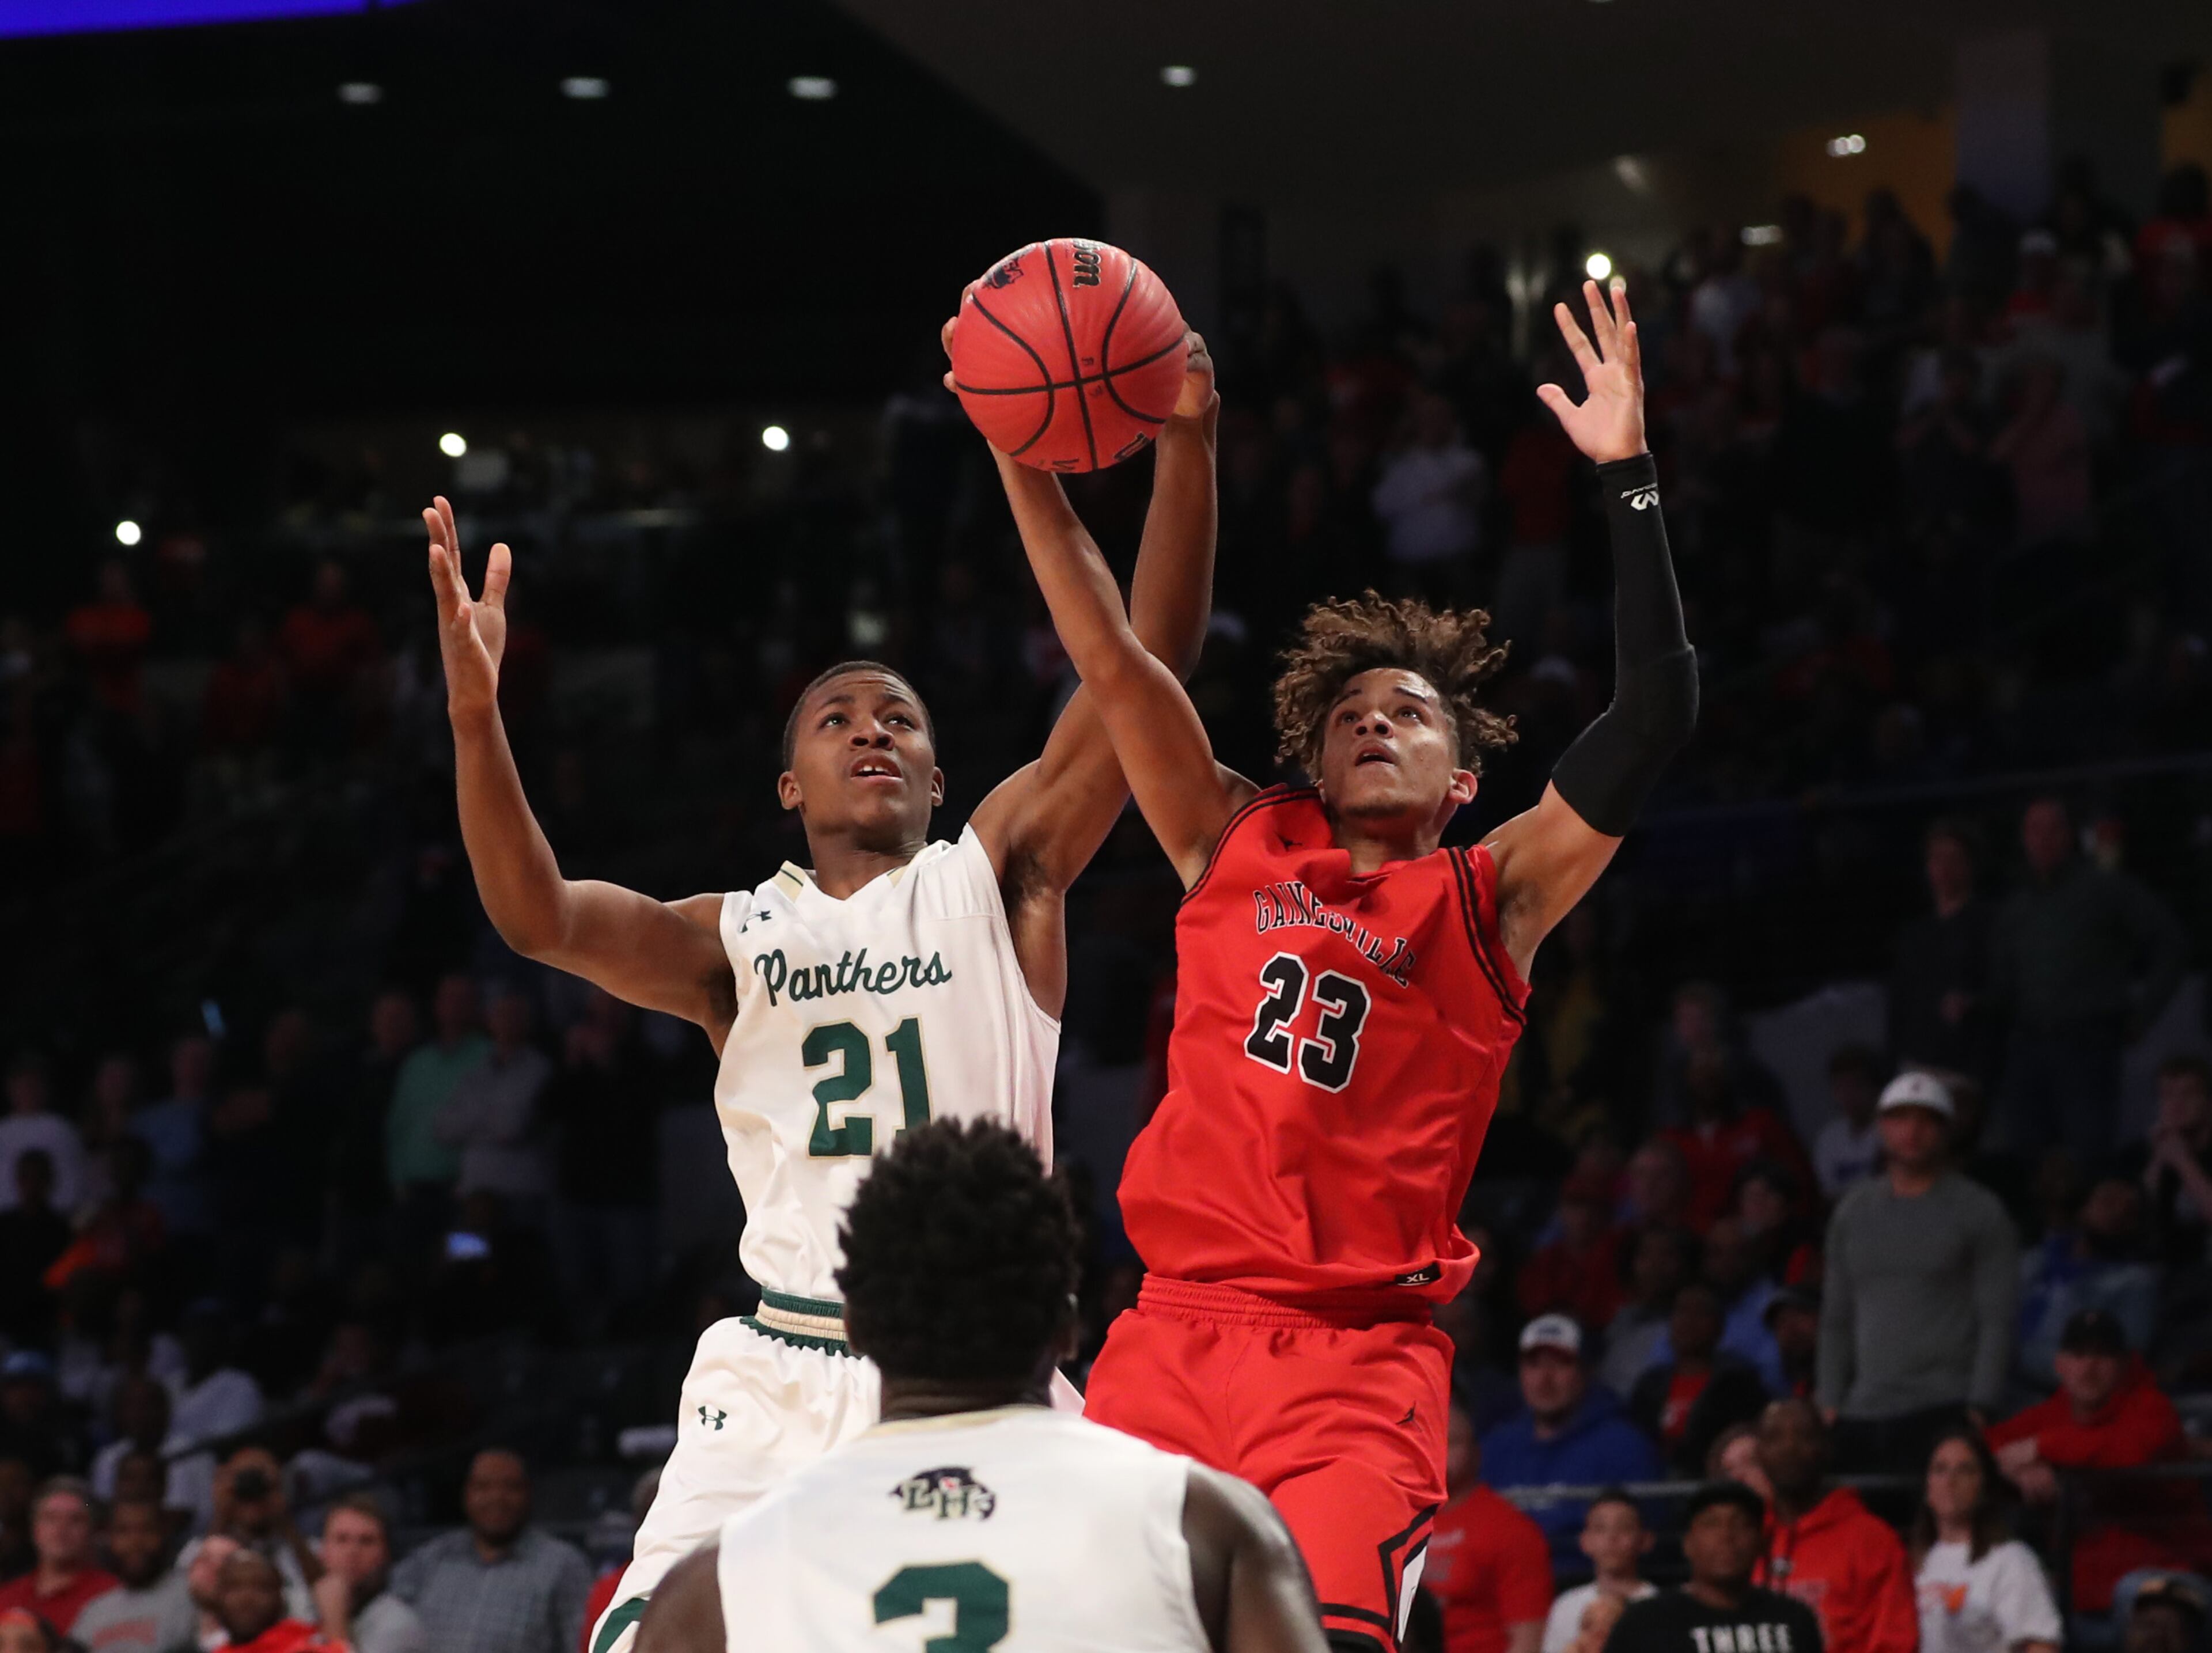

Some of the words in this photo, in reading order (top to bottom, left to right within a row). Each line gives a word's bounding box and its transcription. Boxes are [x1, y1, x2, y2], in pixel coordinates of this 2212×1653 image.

[754, 947, 953, 1007] Panthers
[1243, 951, 1372, 1094] 23
[800, 1014, 934, 1159] 21
[1407, 1273, 1430, 1283] XL
